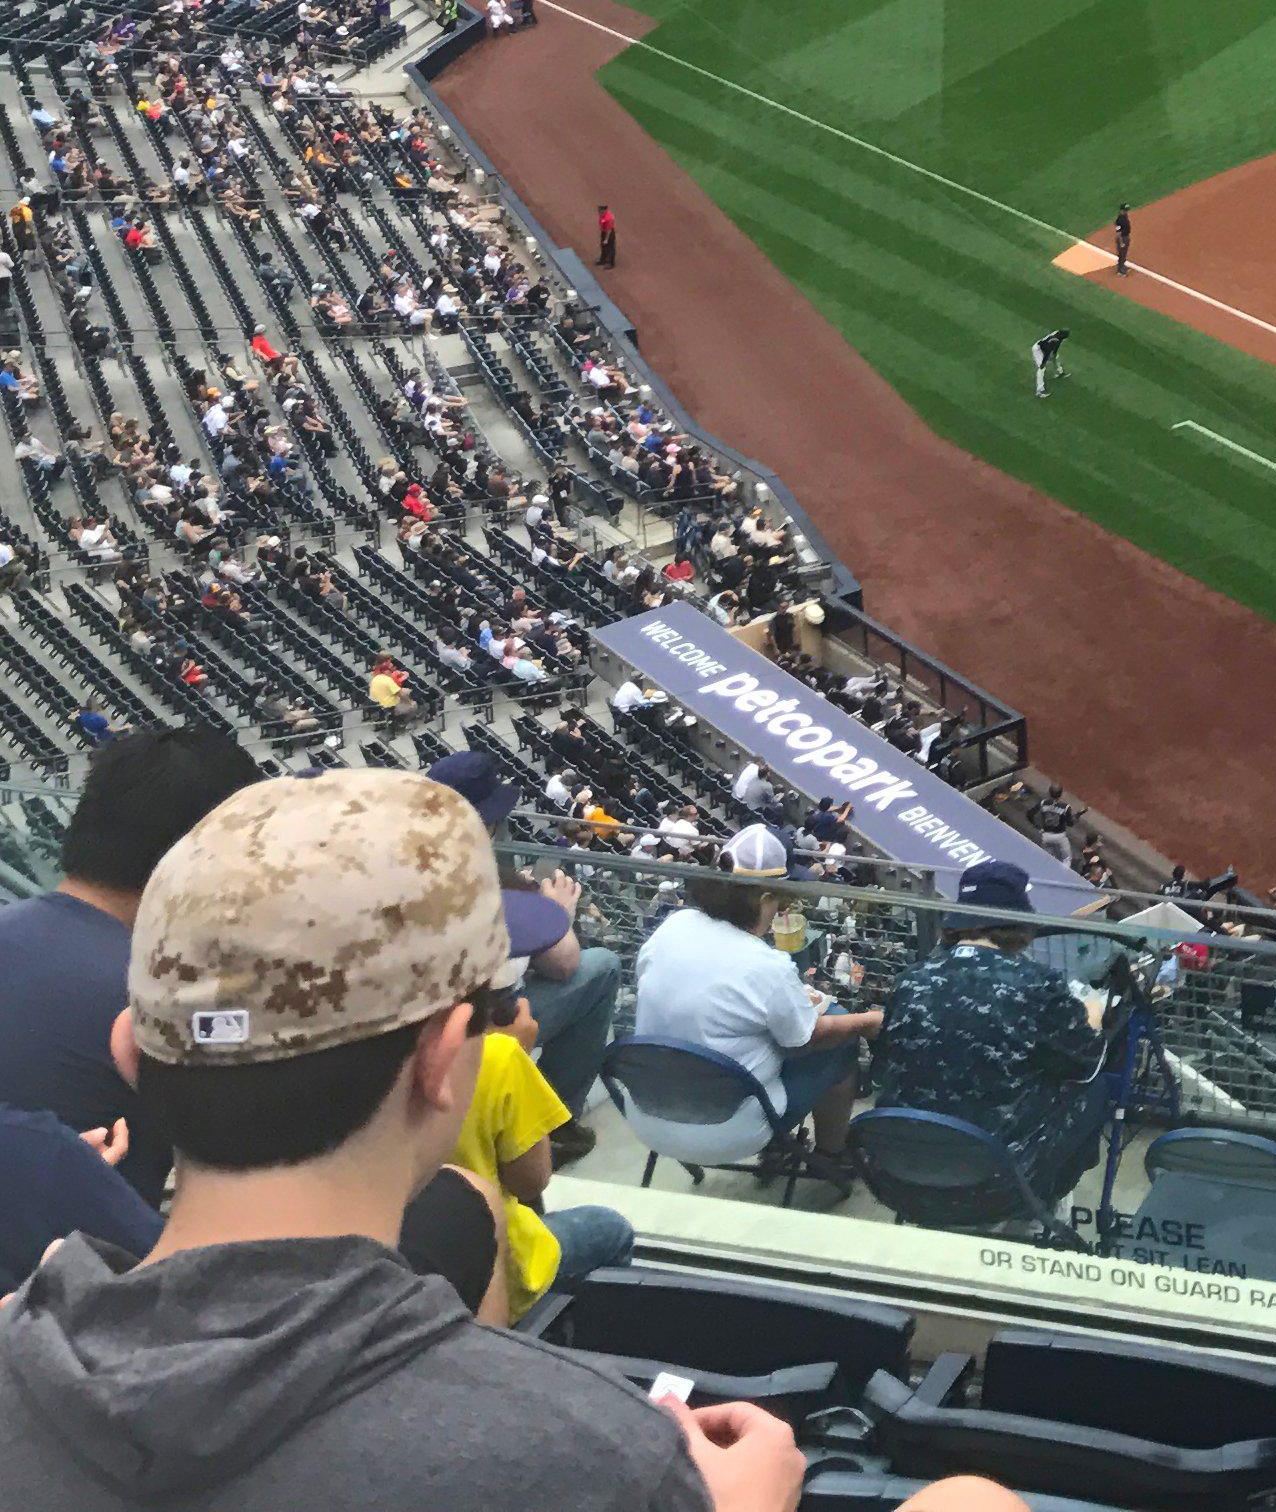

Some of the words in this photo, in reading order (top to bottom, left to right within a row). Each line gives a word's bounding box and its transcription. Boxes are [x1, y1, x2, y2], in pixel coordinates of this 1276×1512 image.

[640, 619, 728, 680] WELCOME
[897, 804, 997, 868] BIENVEN
[979, 1248, 1013, 1269] OR
[1021, 1254, 1102, 1283] STAND
[1111, 1267, 1146, 1290] ON
[1155, 1275, 1241, 1305] GUARD
